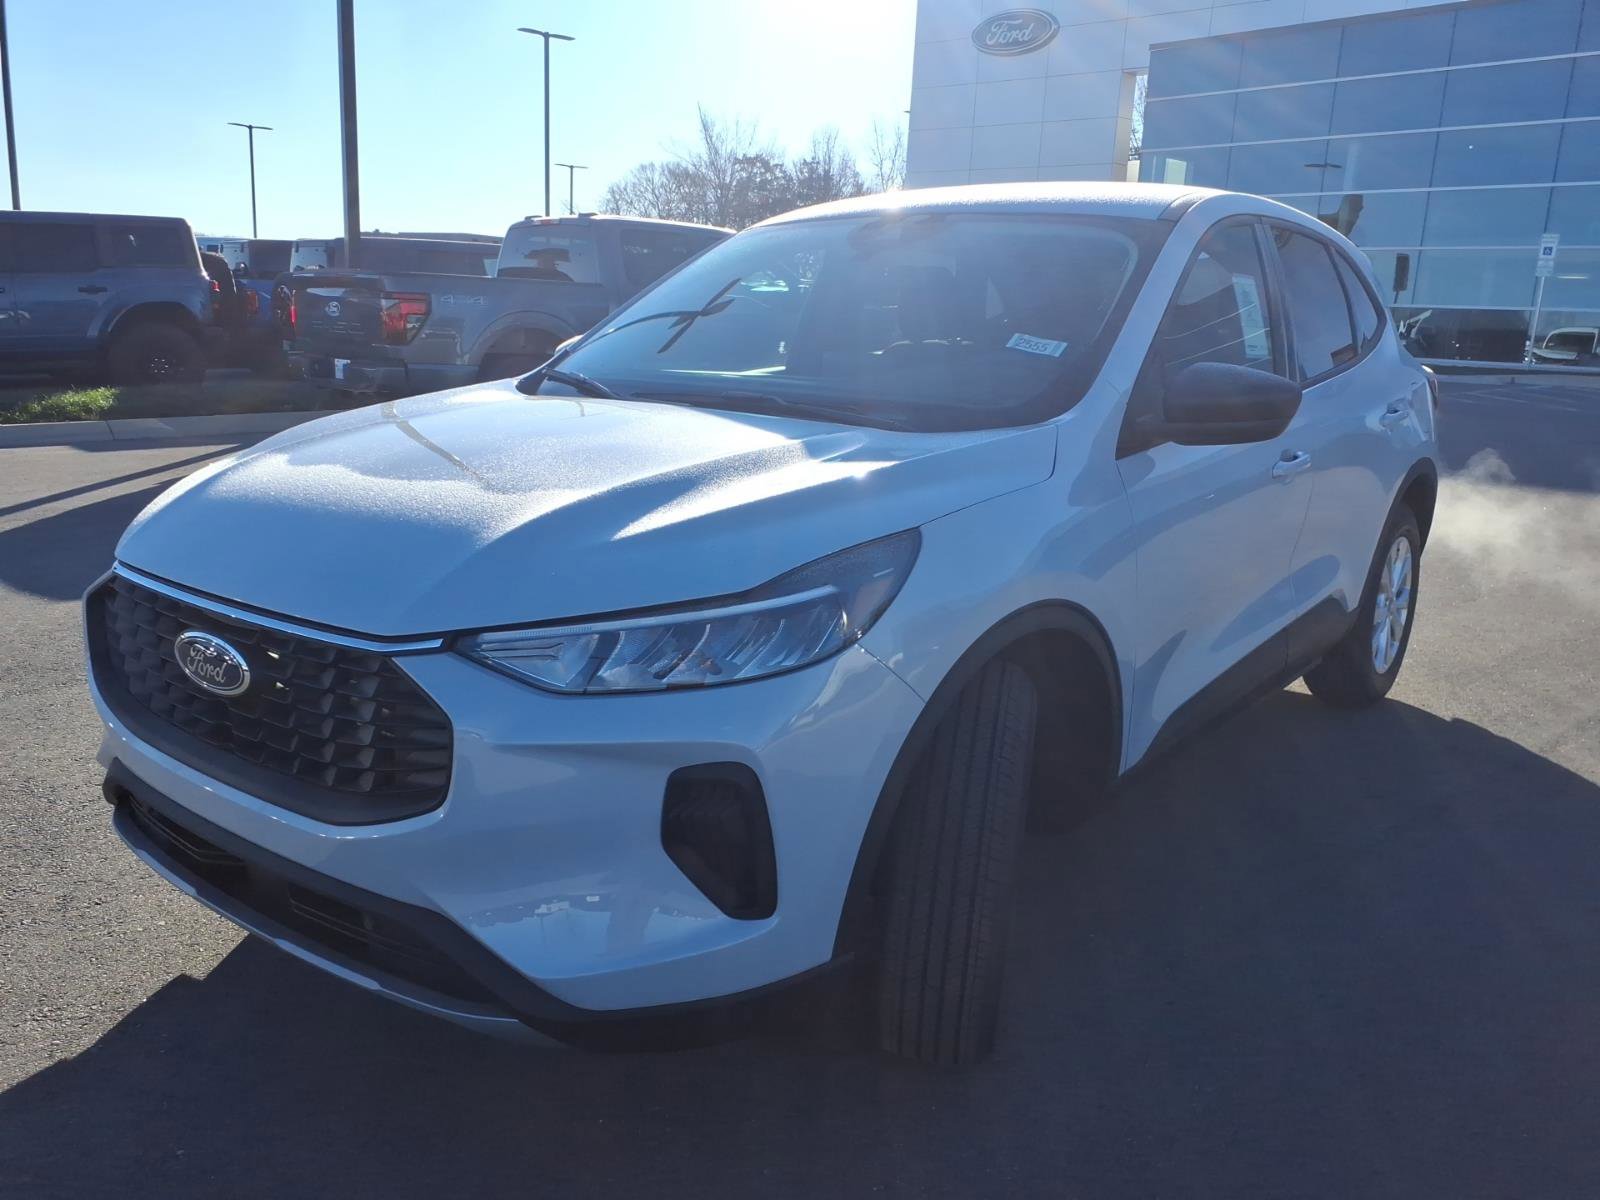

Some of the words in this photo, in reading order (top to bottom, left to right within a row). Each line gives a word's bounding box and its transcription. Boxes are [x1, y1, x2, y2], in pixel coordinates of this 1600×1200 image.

[985, 19, 1034, 46] Ford
[1015, 337, 1049, 352] 2555
[186, 643, 227, 683] Ford
